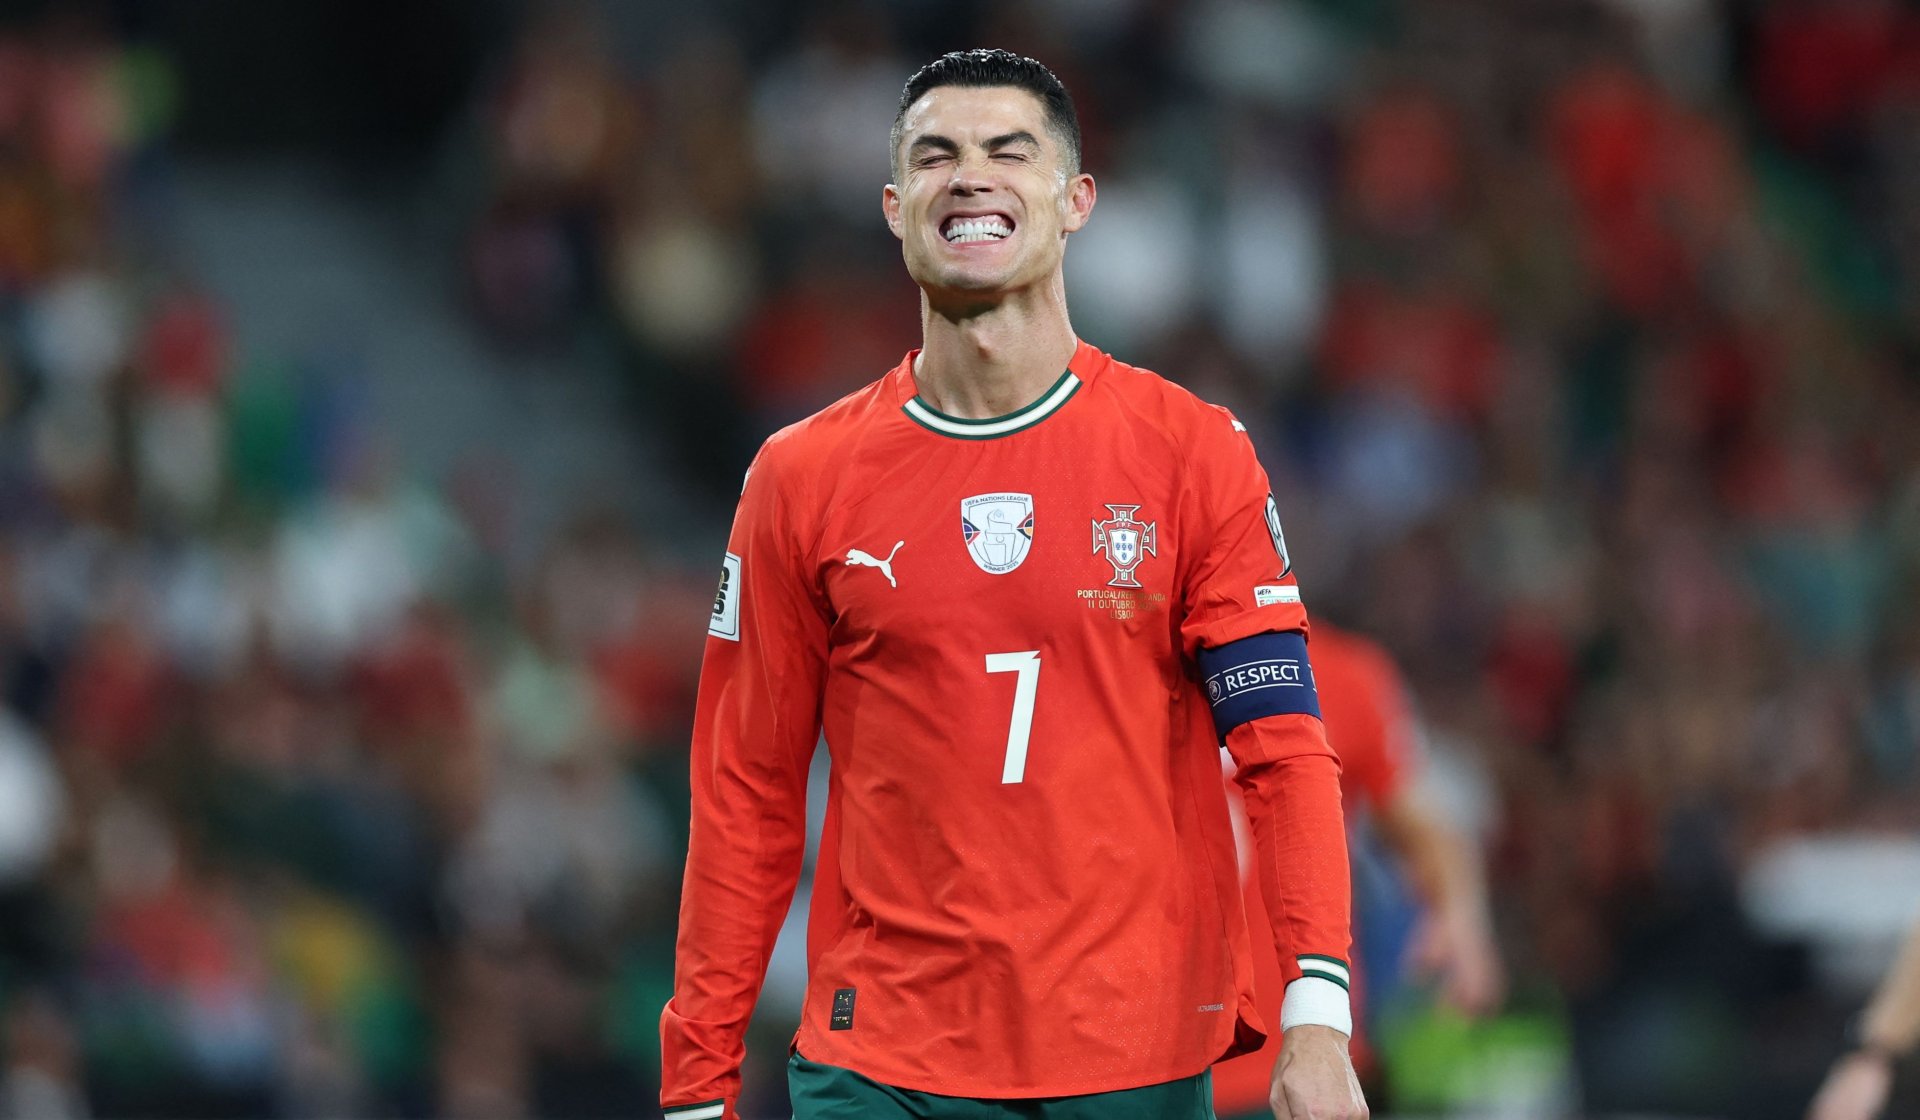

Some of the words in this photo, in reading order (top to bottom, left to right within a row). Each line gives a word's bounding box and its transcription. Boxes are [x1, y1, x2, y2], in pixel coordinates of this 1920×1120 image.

[983, 564, 1006, 572] WINNER
[1098, 600, 1136, 609] OUTUBRO
[1110, 610, 1134, 619] LISBOA
[1225, 665, 1300, 691] RESPECT
[985, 650, 1042, 784] 7
